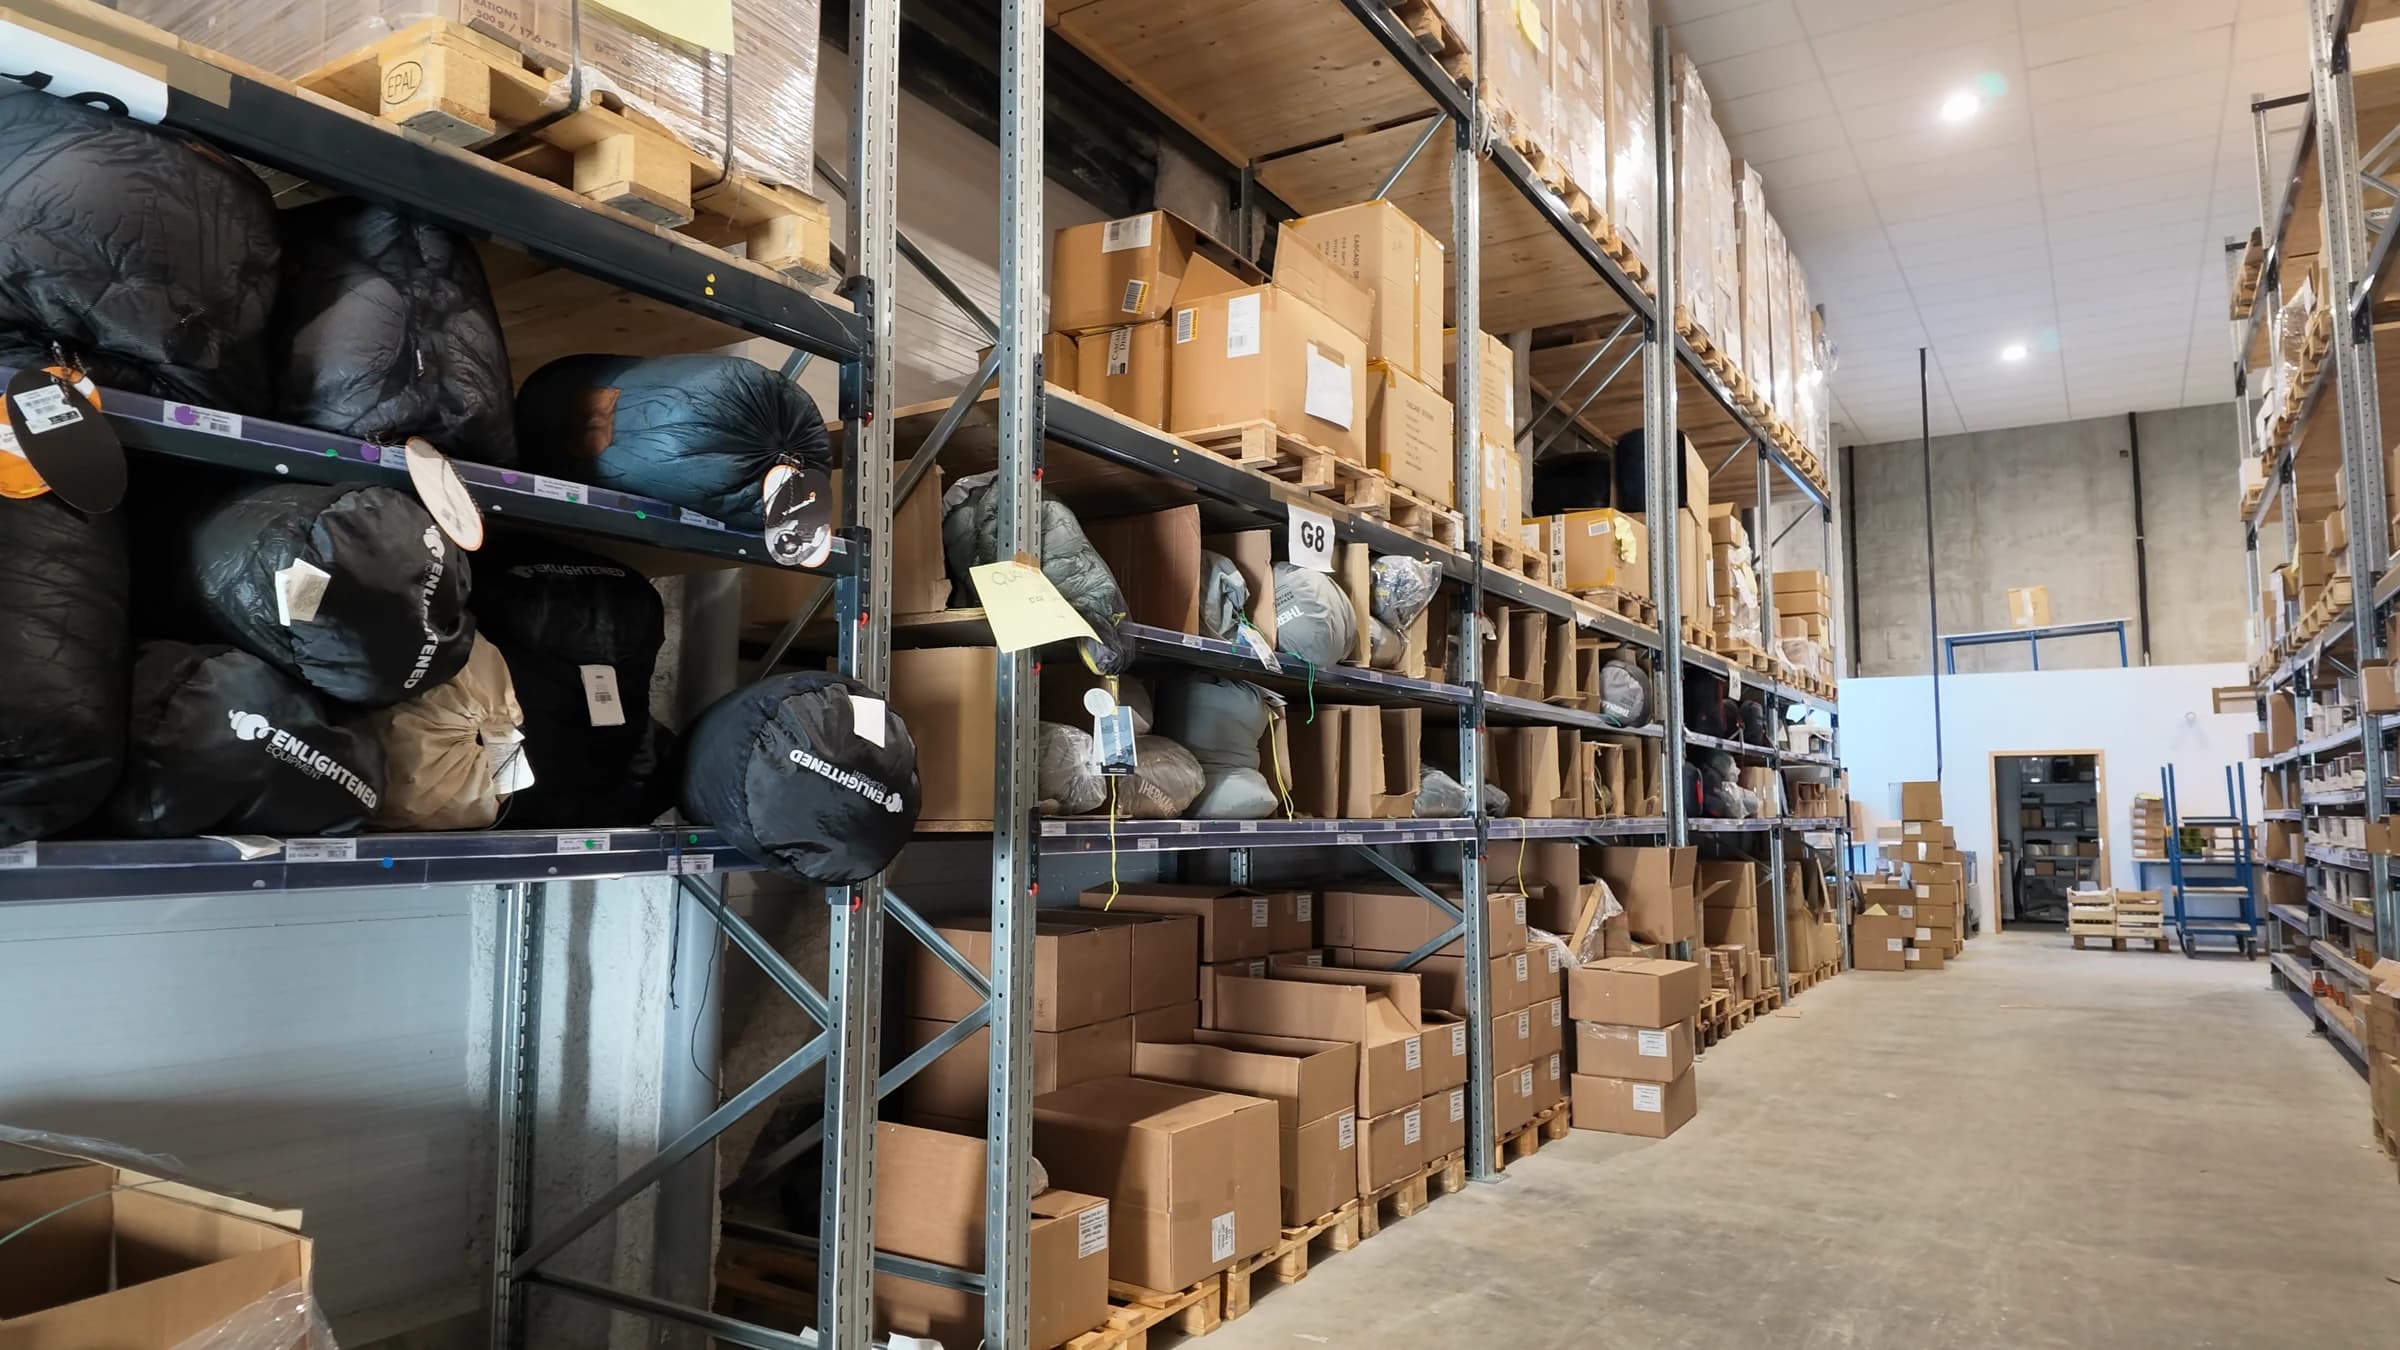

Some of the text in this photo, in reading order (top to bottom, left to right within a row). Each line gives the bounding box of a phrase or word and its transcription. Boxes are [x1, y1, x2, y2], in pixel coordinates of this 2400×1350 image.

[387, 69, 416, 98] EPAL
[1300, 520, 1325, 552] G8
[265, 742, 323, 781] EQUIPMENT
[271, 729, 377, 809] ENLIGHTENED
[789, 749, 885, 805] ENLIGHTENED
